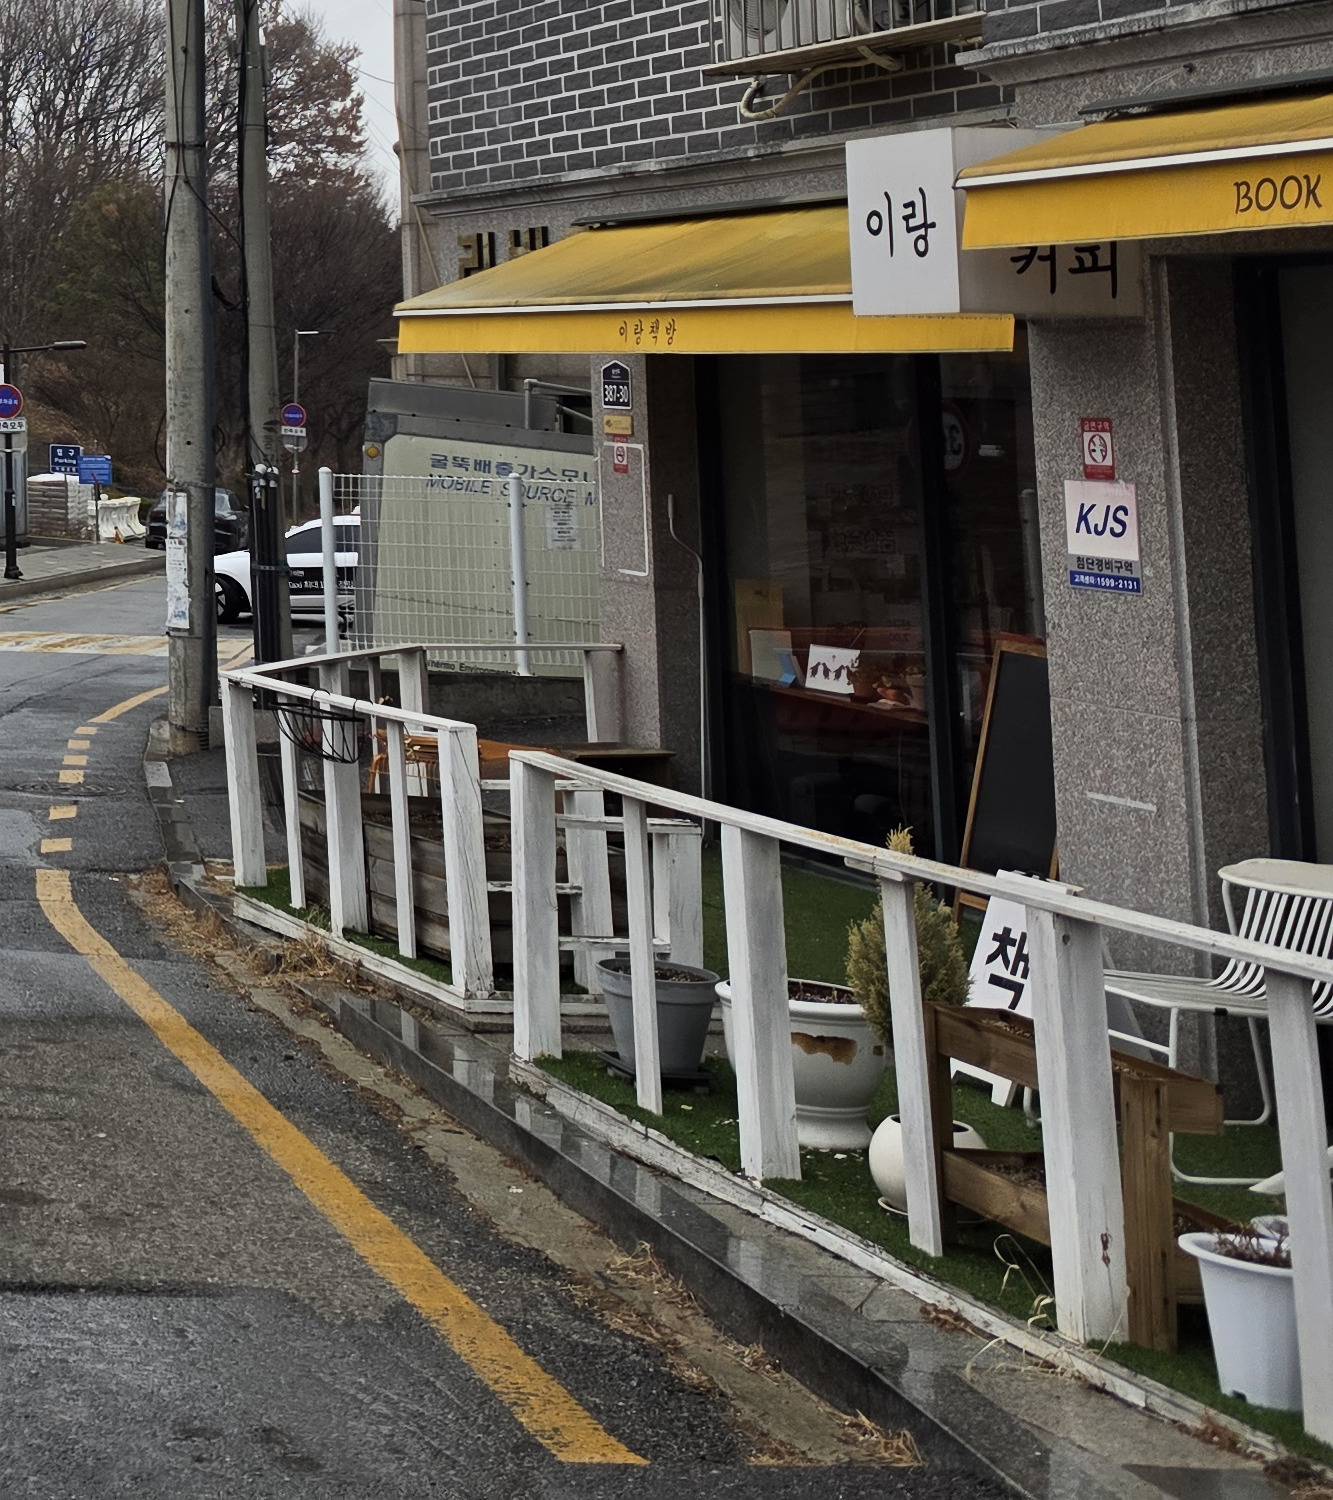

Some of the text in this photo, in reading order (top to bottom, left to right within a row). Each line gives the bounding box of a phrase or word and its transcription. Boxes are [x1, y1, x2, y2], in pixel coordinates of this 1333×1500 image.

[1234, 173, 1323, 215] BOOK
[865, 186, 937, 258] 이랑
[1009, 240, 1118, 299] 커피
[604, 384, 629, 403] 387-30
[1083, 420, 1110, 432] 금연구역
[426, 474, 493, 495] MOBILE
[500, 483, 577, 504] SURCE
[1075, 503, 1129, 538] KJS
[1076, 556, 1133, 575] 첨단경비구역
